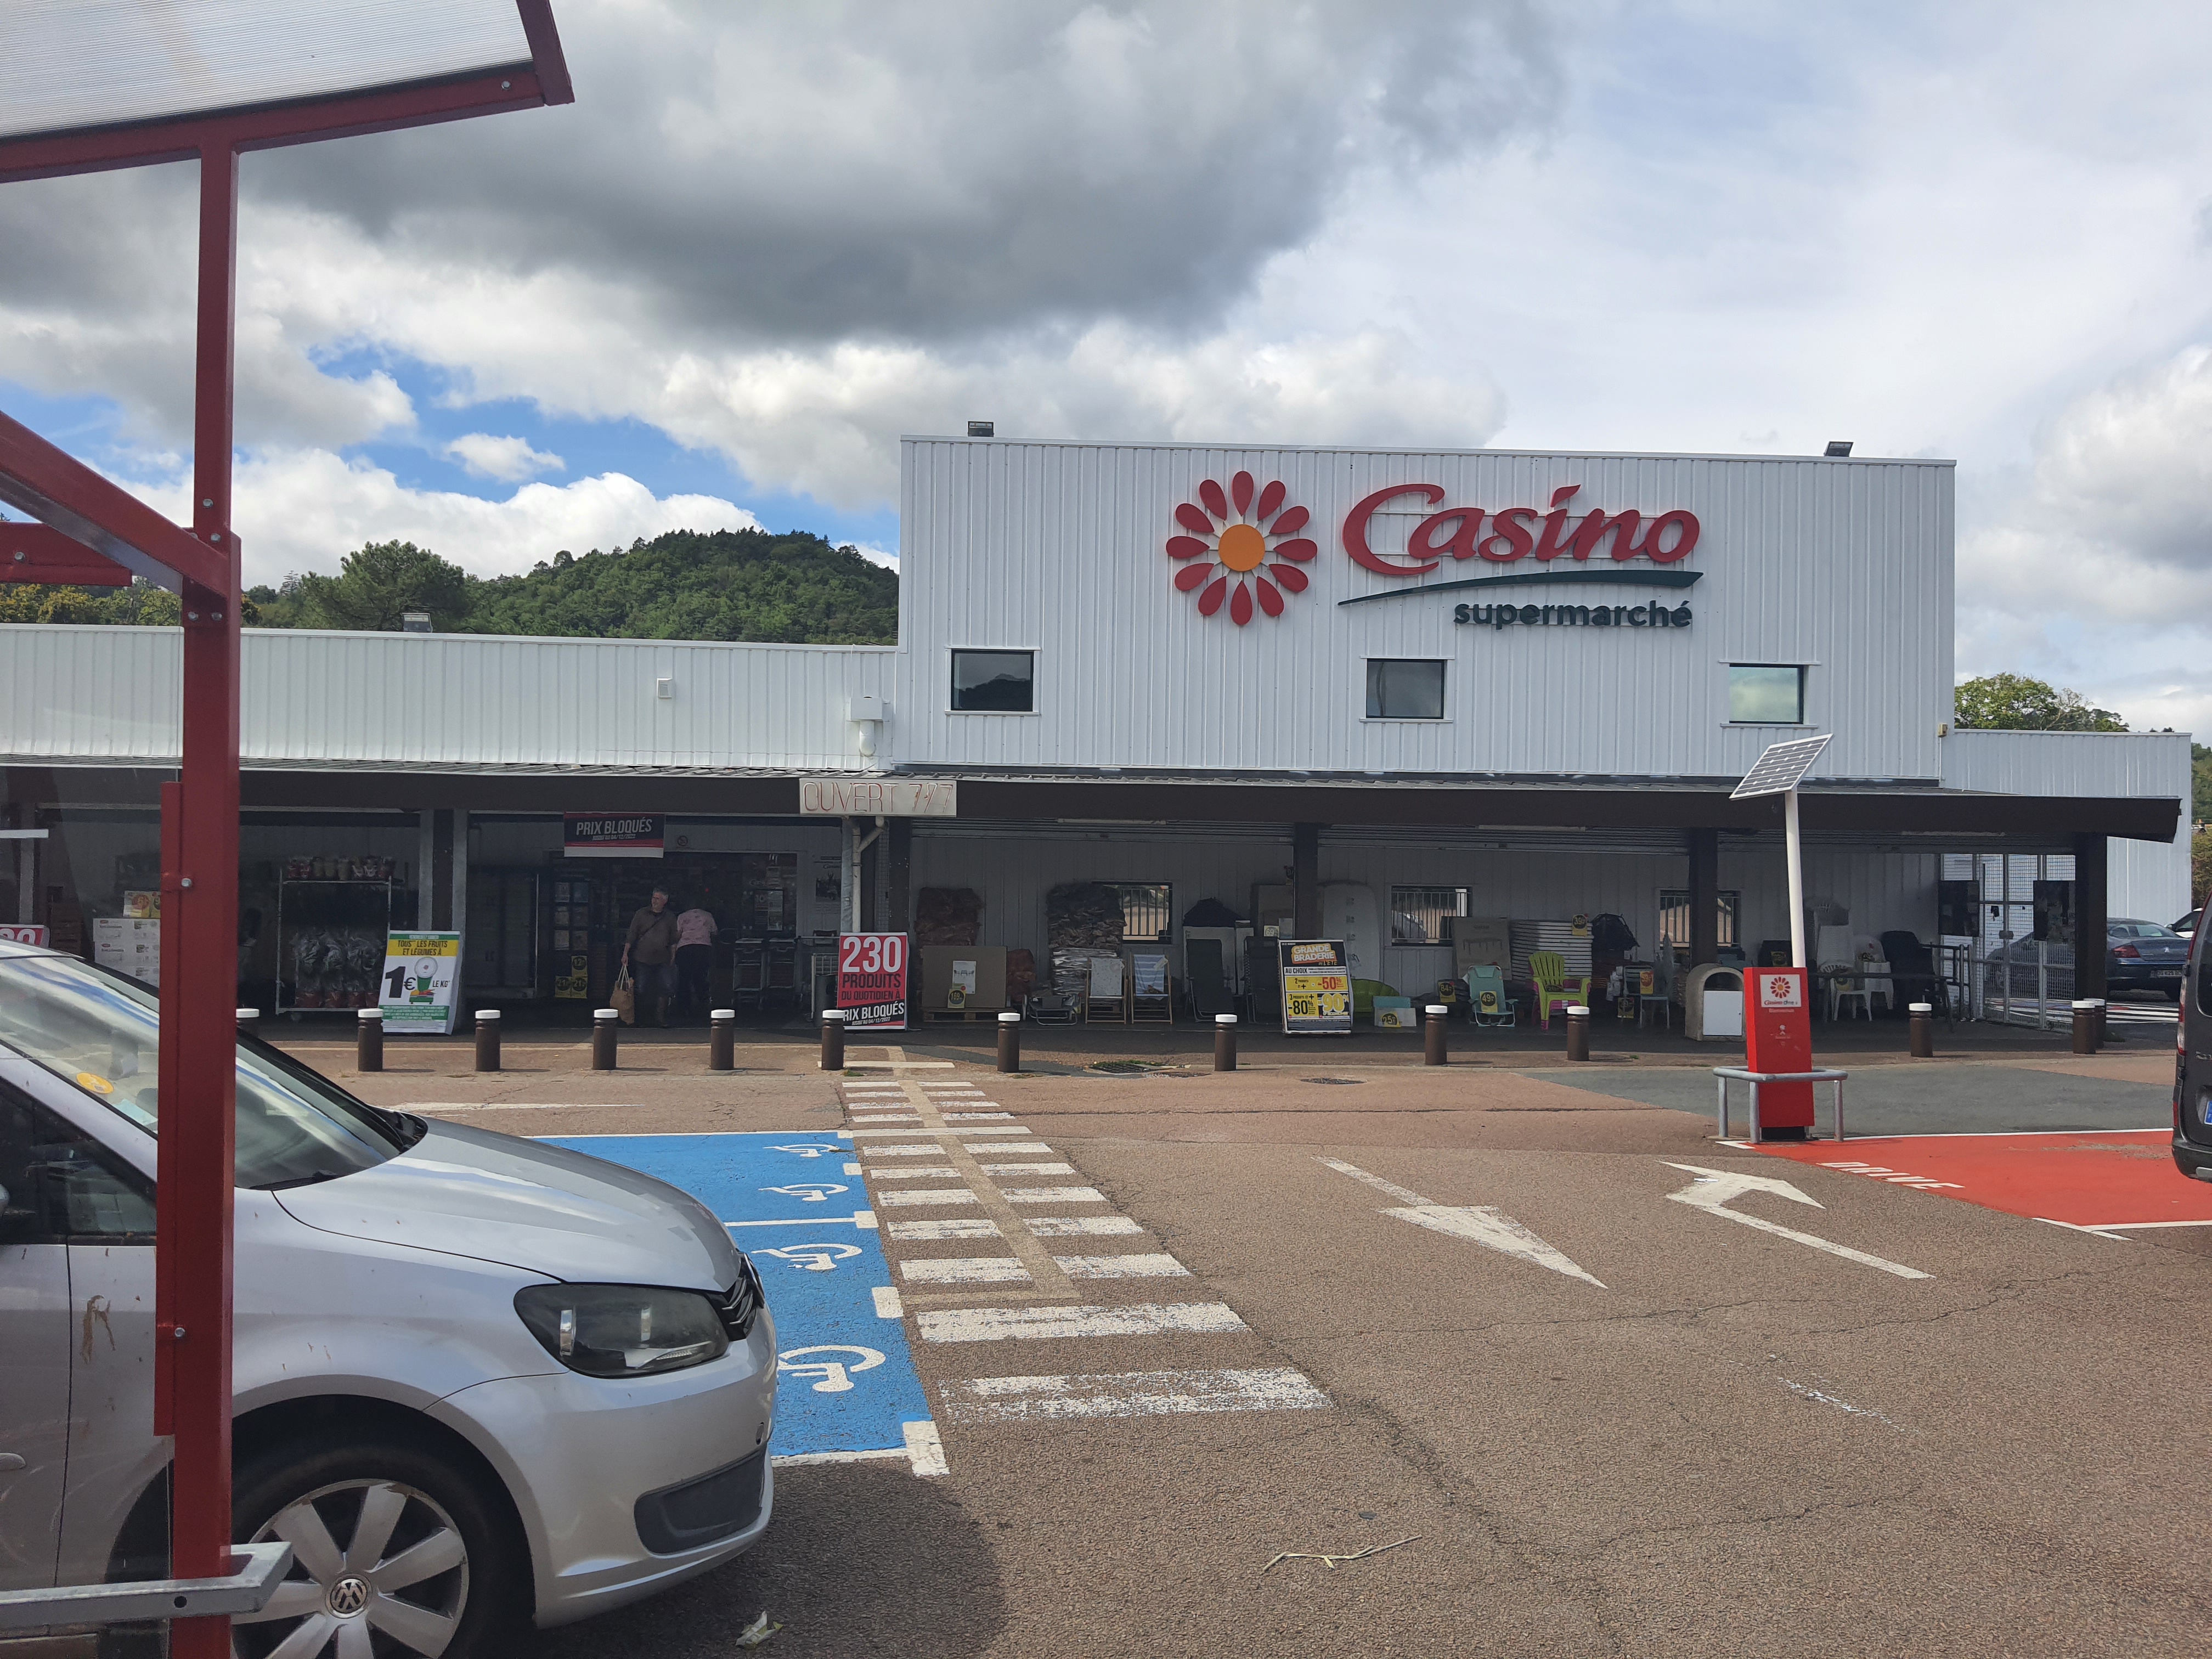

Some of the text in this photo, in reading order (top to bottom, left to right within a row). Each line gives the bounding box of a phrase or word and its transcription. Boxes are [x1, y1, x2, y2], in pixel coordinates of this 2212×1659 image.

[1343, 483, 1700, 576] Casino
[1453, 600, 1692, 630] supermarché
[803, 782, 899, 812] OUVERT
[576, 816, 652, 836] PRIX BLOQUÉS
[842, 936, 901, 973] 230
[1294, 952, 1335, 962] BRADERIE
[1295, 945, 1330, 954] GRANDE
[385, 966, 416, 998] 1 €
[843, 974, 901, 989] PRODUITS
[842, 989, 901, 1000] DU QUOTIDIEN À
[843, 1001, 905, 1022] RIX BLOQUÉS
[1816, 1161, 1966, 1189] DRIVE
